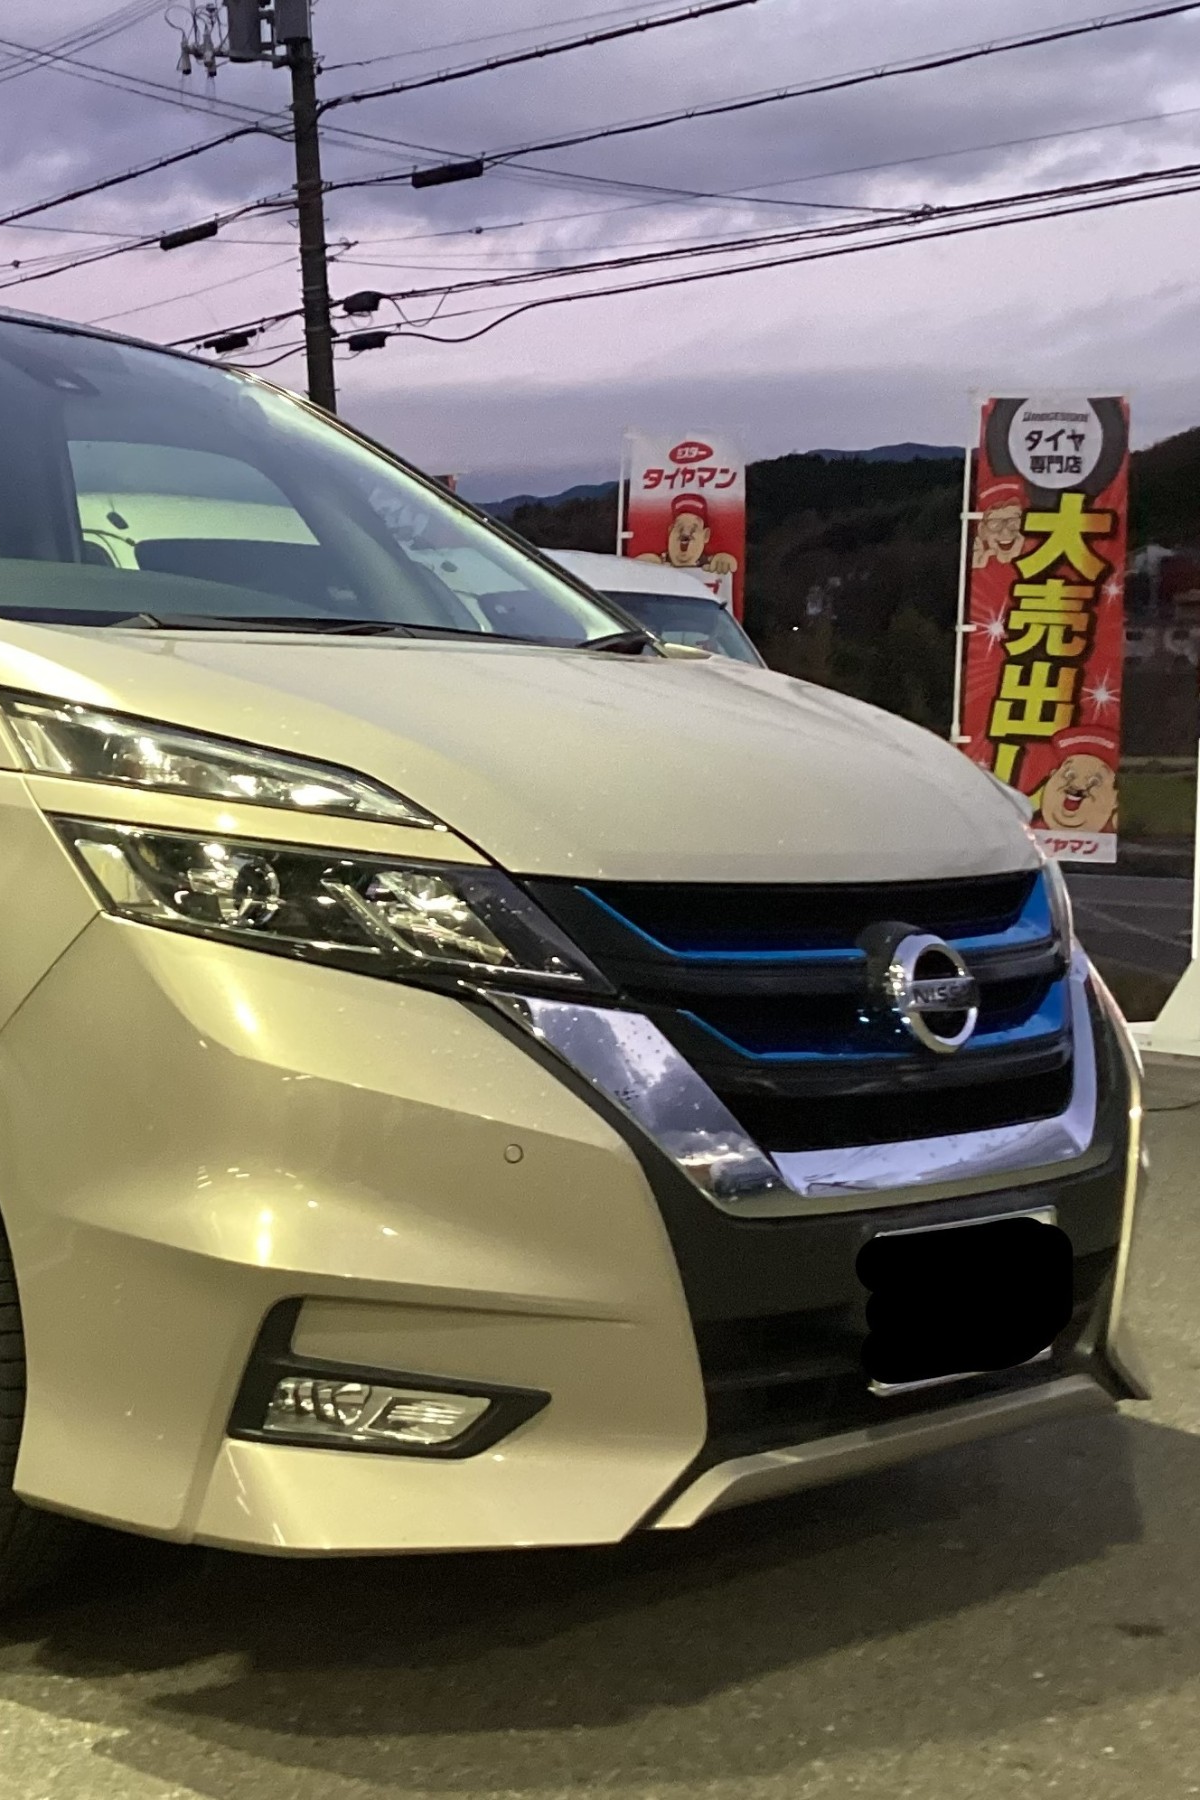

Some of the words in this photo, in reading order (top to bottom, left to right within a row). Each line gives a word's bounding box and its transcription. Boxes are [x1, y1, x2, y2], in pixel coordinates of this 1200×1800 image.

[1024, 428, 1087, 451] タイヤ
[1029, 454, 1083, 474] 専門店
[642, 466, 738, 490] タイヤマン
[912, 983, 973, 1005] NISS
